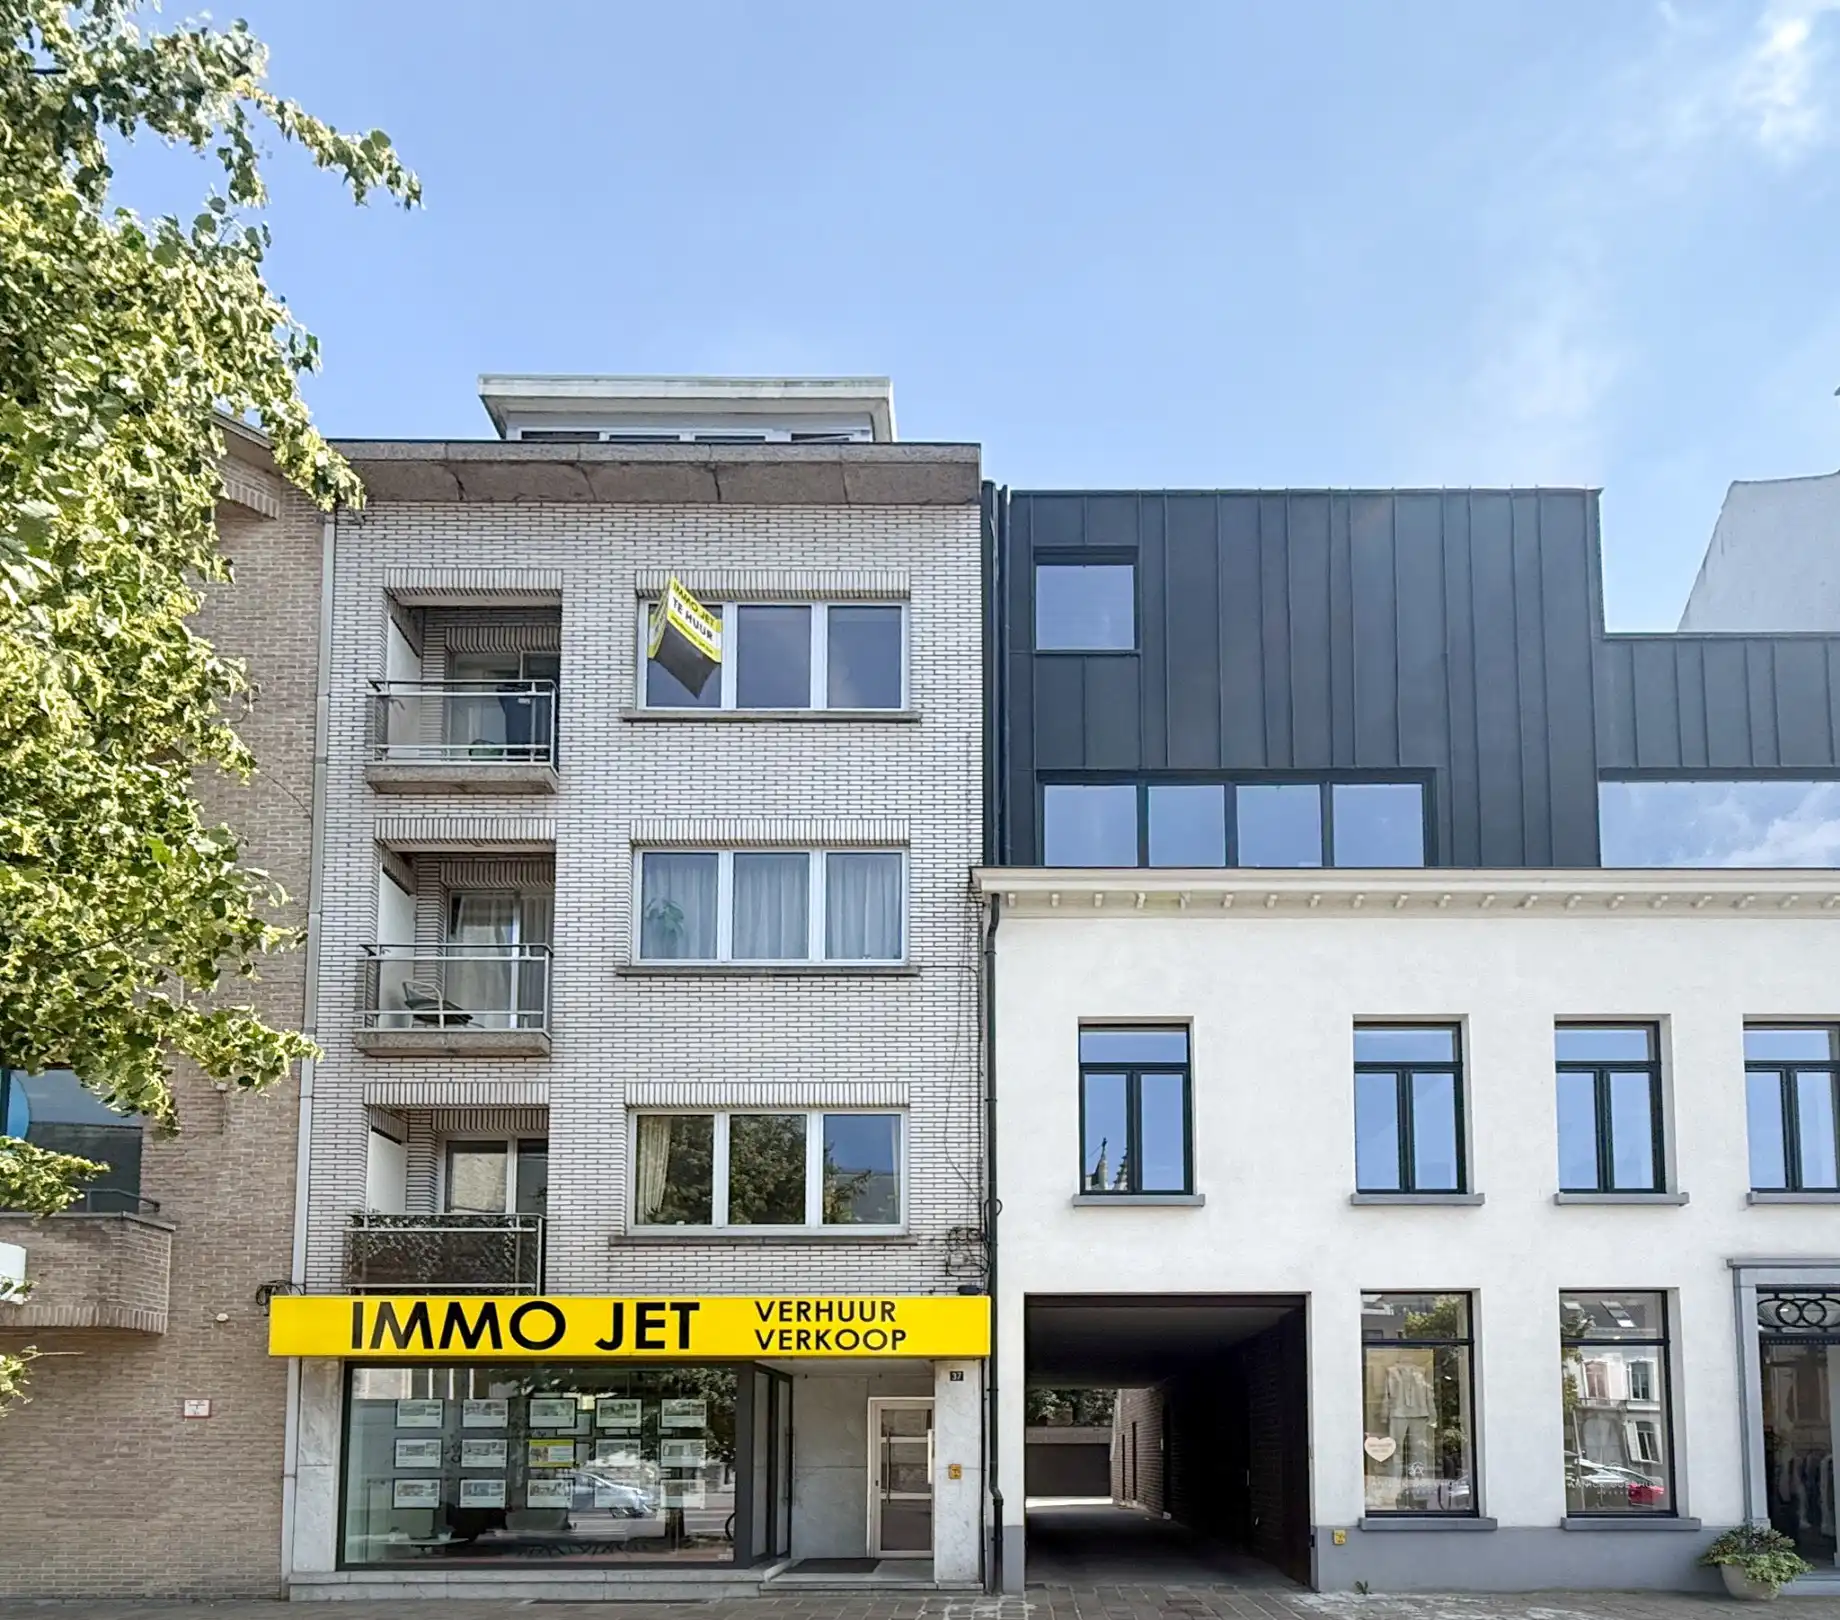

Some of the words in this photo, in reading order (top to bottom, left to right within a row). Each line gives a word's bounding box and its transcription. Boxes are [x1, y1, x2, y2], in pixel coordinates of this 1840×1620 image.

[673, 596, 683, 615] TE
[685, 610, 713, 641] HUUR
[755, 1300, 896, 1323] VERHUUR
[351, 1300, 567, 1351] IMMO
[594, 1301, 701, 1351] JET
[755, 1328, 907, 1351] VERKOOP
[951, 1372, 962, 1381] 37
